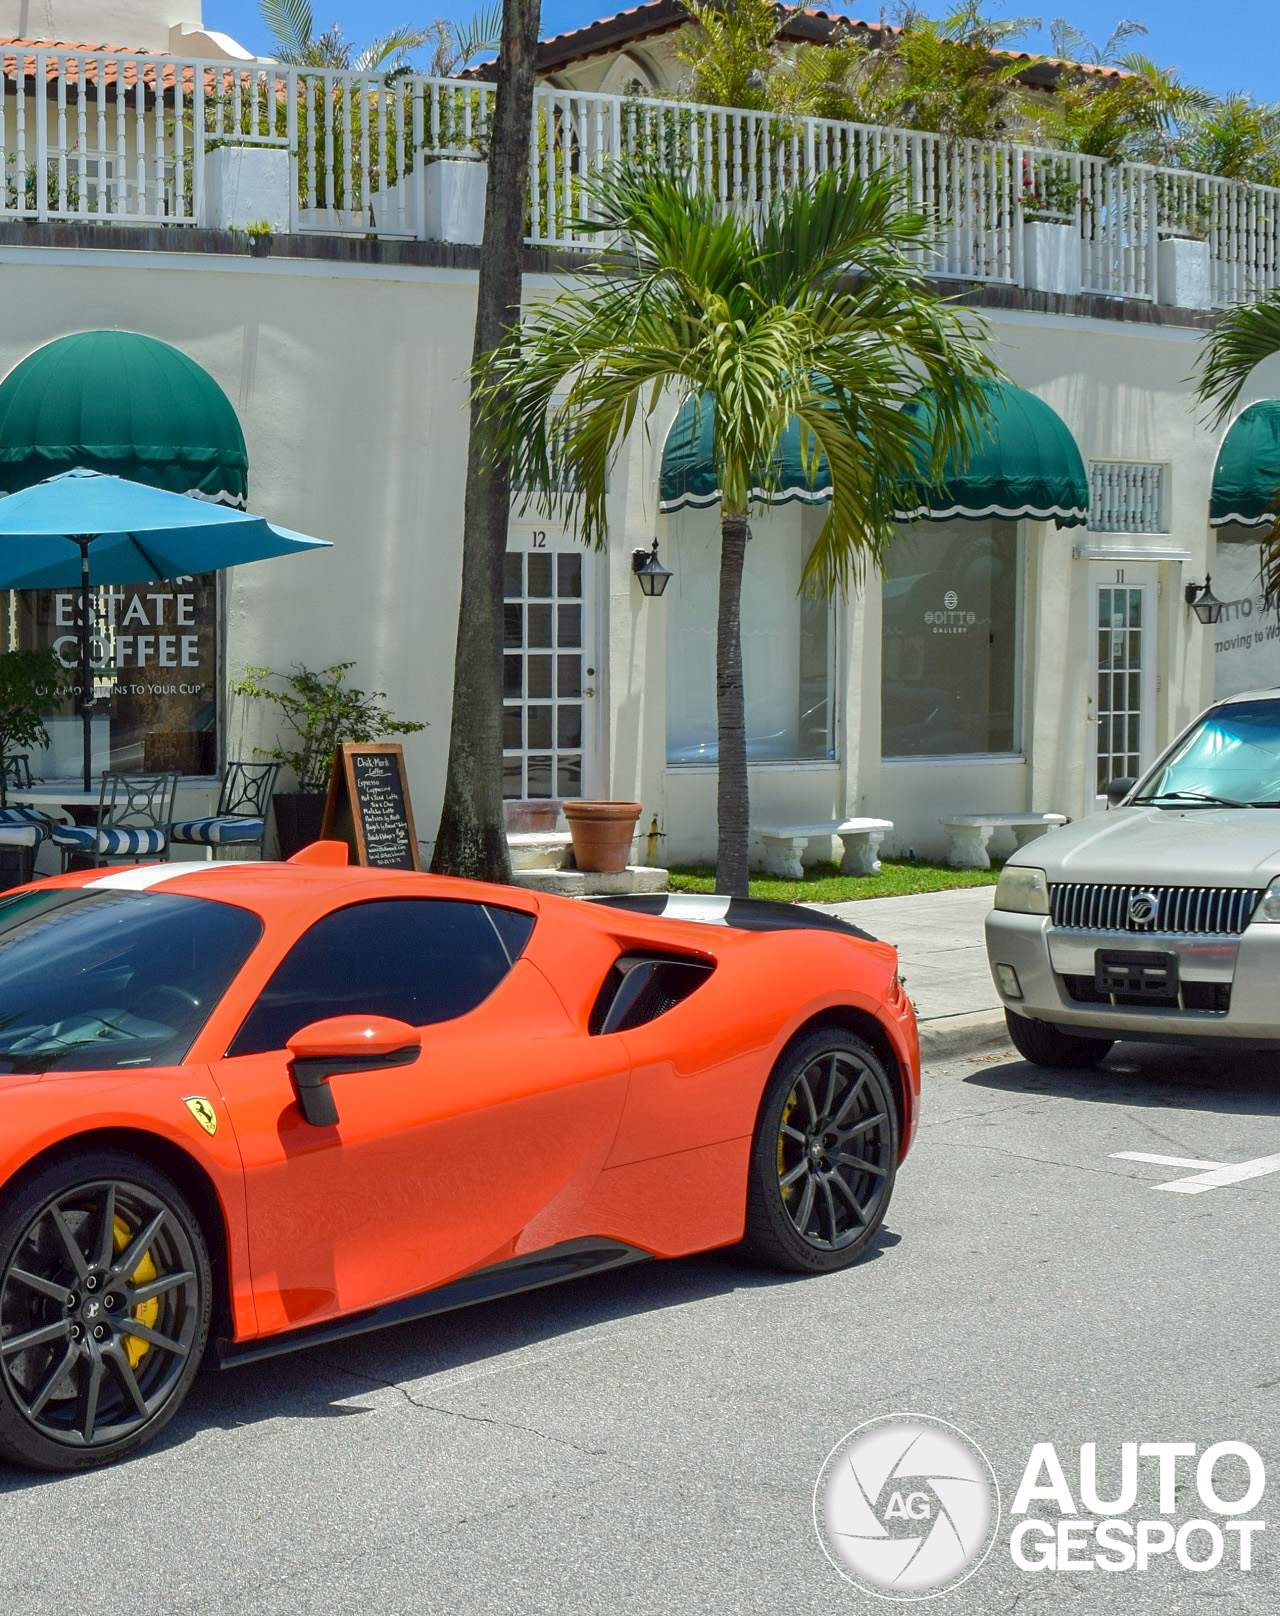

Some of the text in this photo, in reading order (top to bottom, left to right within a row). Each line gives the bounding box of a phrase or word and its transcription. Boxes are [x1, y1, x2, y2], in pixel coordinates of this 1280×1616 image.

[532, 531, 546, 548] 12
[1116, 569, 1124, 583] 11
[55, 594, 195, 626] ESTATE
[1214, 634, 1253, 653] moving
[1254, 631, 1264, 643] to
[52, 635, 200, 669] COFFEE
[62, 686, 127, 696] MONTAINS
[130, 684, 145, 694] TO
[147, 684, 177, 695] YOUR
